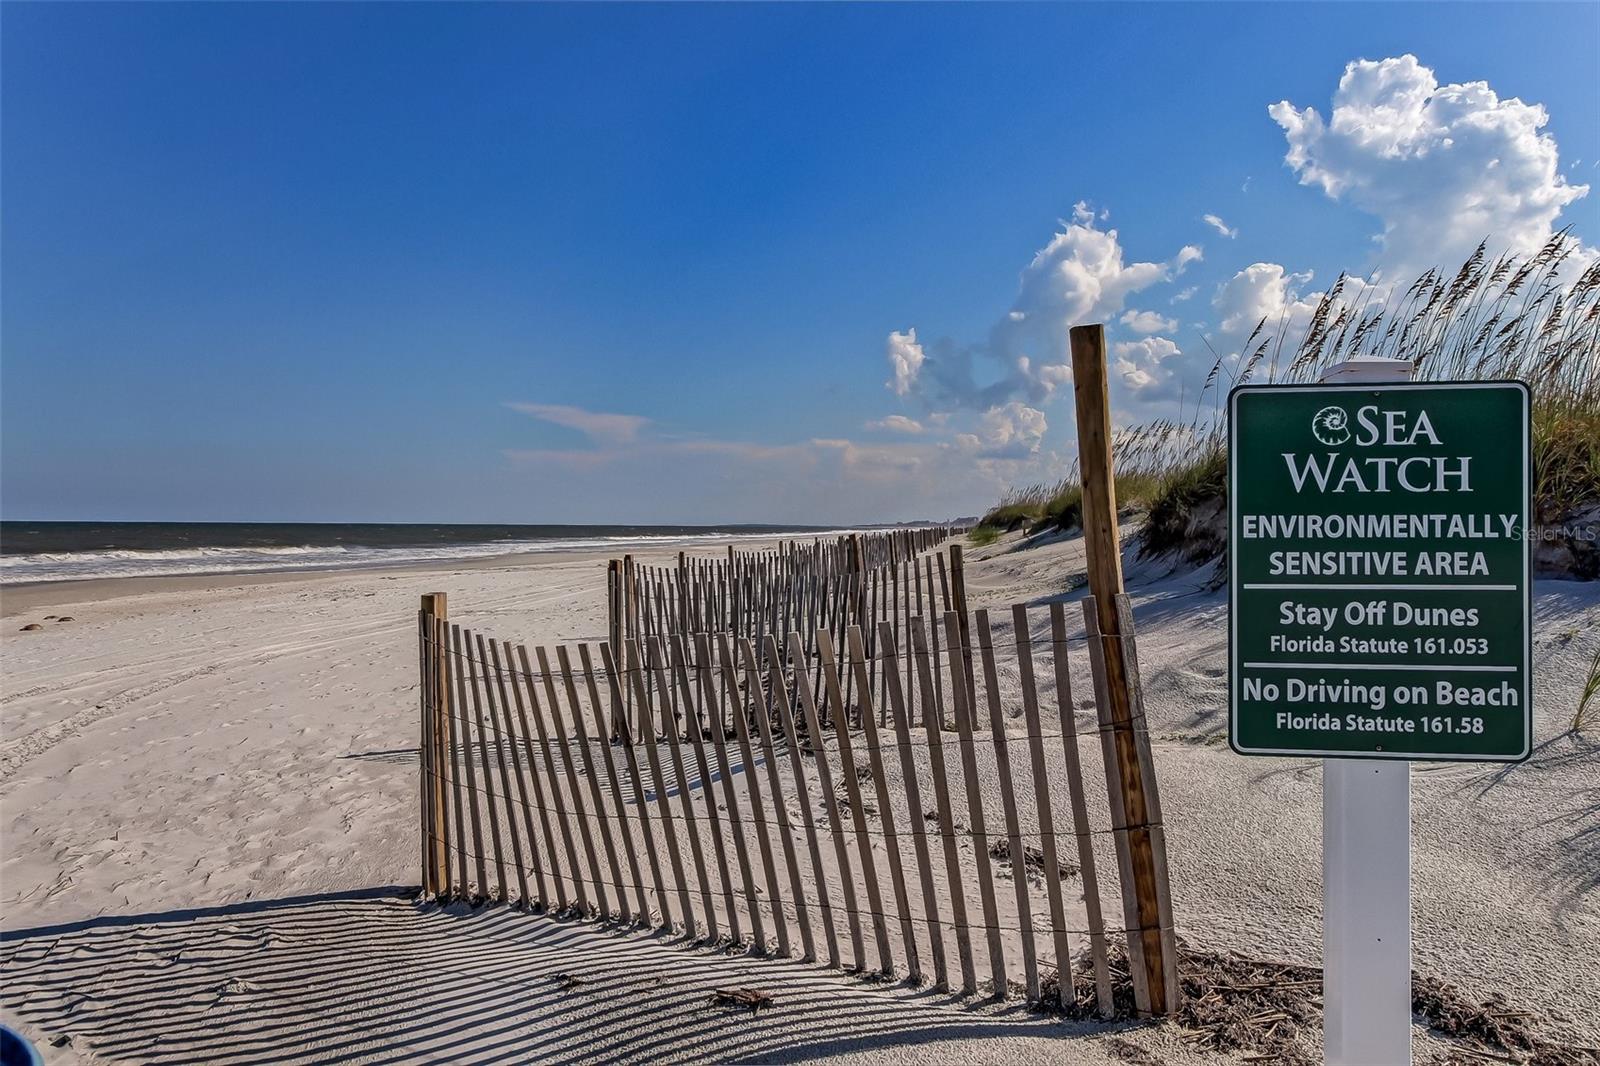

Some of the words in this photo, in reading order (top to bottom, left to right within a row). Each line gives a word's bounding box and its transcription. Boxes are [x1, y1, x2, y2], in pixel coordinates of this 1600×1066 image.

[1243, 515, 1518, 538] ENVIRONMENTALLY
[1270, 552, 1407, 575] SENSITIVE
[1415, 552, 1489, 575] AREA
[1280, 601, 1338, 631] Stay
[1345, 601, 1386, 625] Off
[1393, 602, 1478, 626] Dunes
[1271, 635, 1334, 652] Florida
[1340, 636, 1408, 653] Statute
[1414, 638, 1488, 654] 161.053
[1244, 678, 1279, 701] No
[1287, 679, 1385, 710] Driving
[1394, 687, 1427, 704] on
[1438, 681, 1518, 705] Beach
[1277, 712, 1340, 730] Florida
[1346, 714, 1415, 732] Statute
[1421, 717, 1483, 733] 161.58
